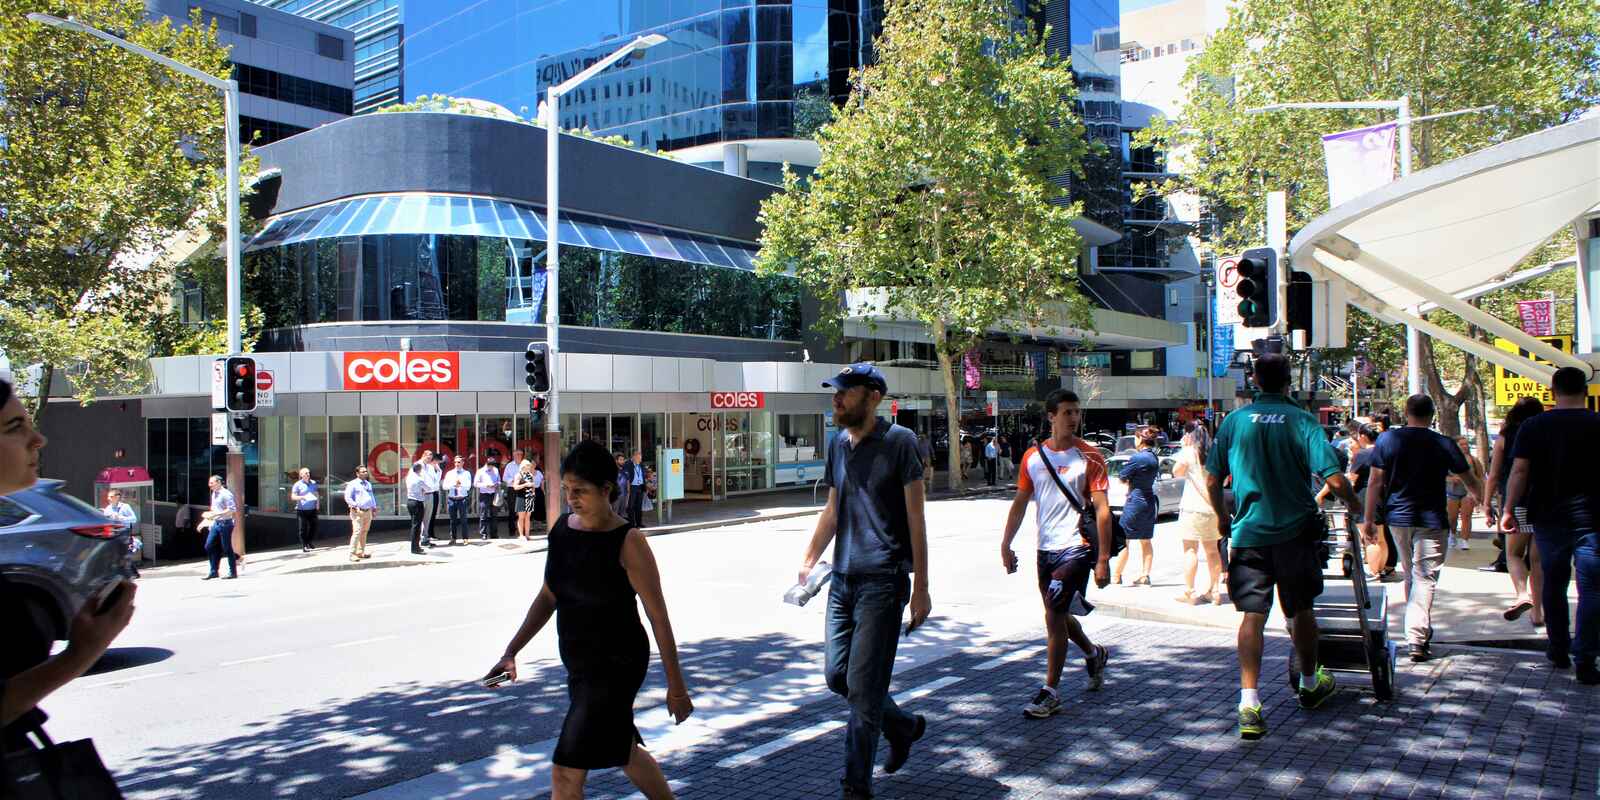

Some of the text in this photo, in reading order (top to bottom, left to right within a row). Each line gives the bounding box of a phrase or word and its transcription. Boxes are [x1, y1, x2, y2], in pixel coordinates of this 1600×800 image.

[348, 352, 452, 383] coles
[1505, 383, 1552, 391] LOWES
[713, 391, 758, 408] coles
[1507, 393, 1550, 402] PRICE
